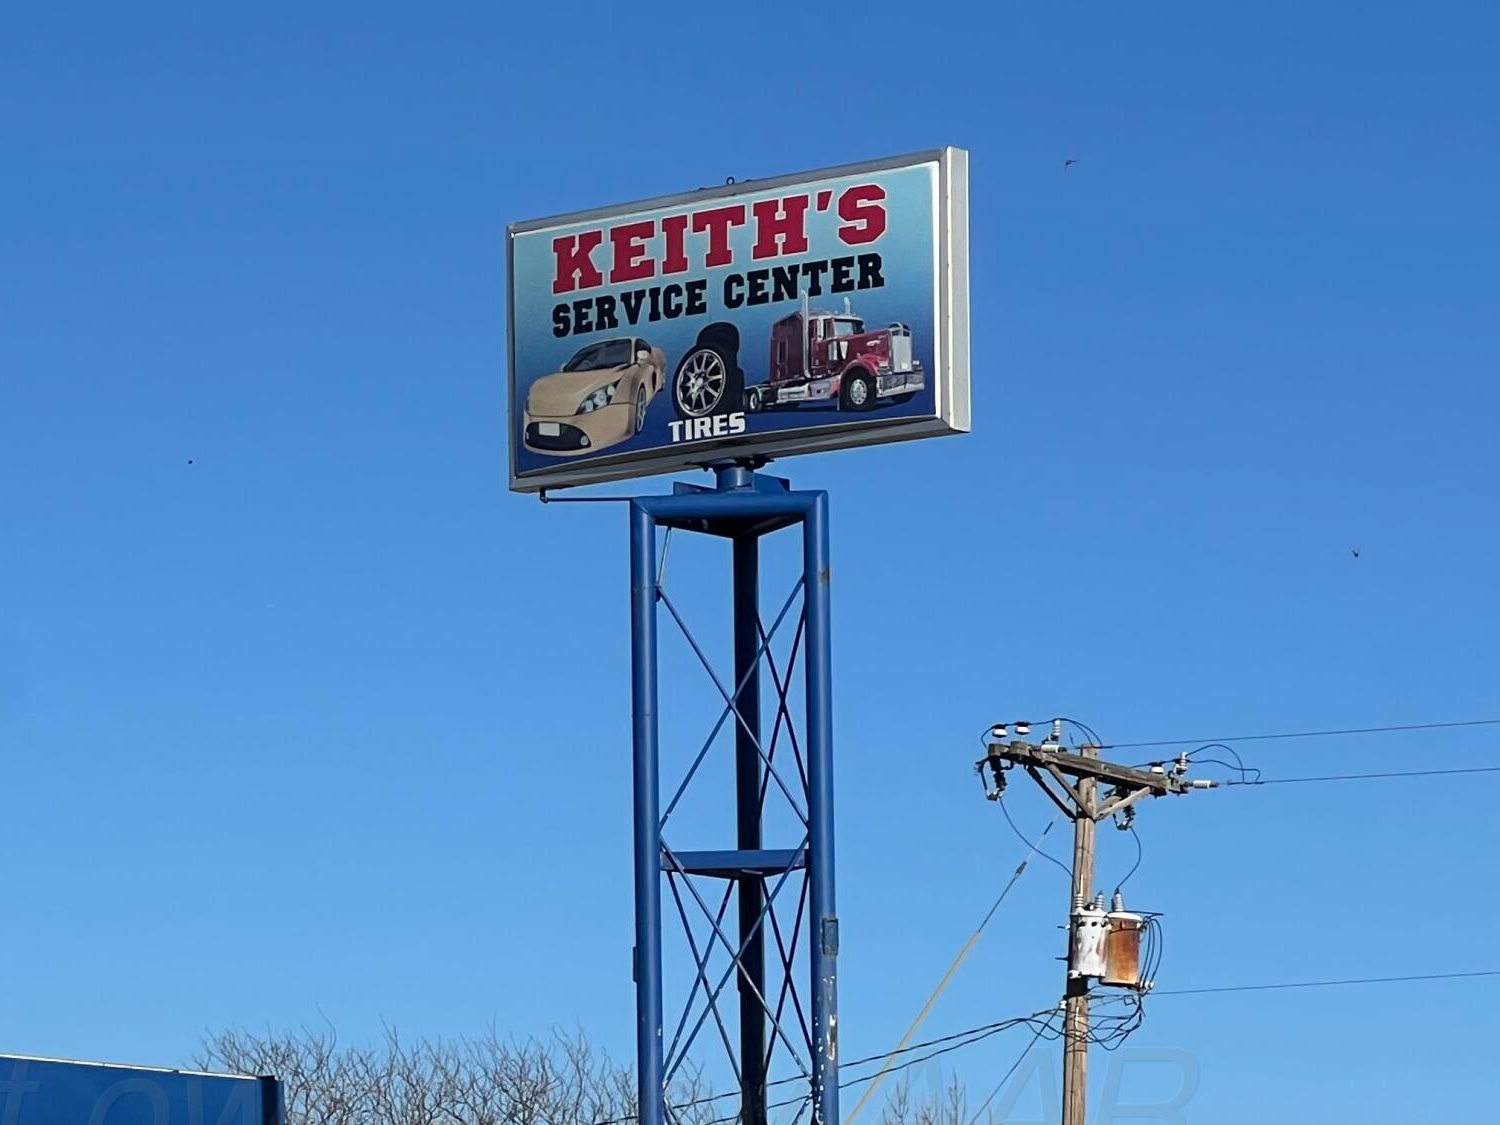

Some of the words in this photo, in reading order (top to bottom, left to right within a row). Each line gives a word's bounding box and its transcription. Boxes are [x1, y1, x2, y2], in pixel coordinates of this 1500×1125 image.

[552, 184, 887, 295] KEITH'S
[552, 279, 707, 338] SERVICE
[723, 253, 885, 309] CENTER
[668, 412, 746, 443] TIRES
